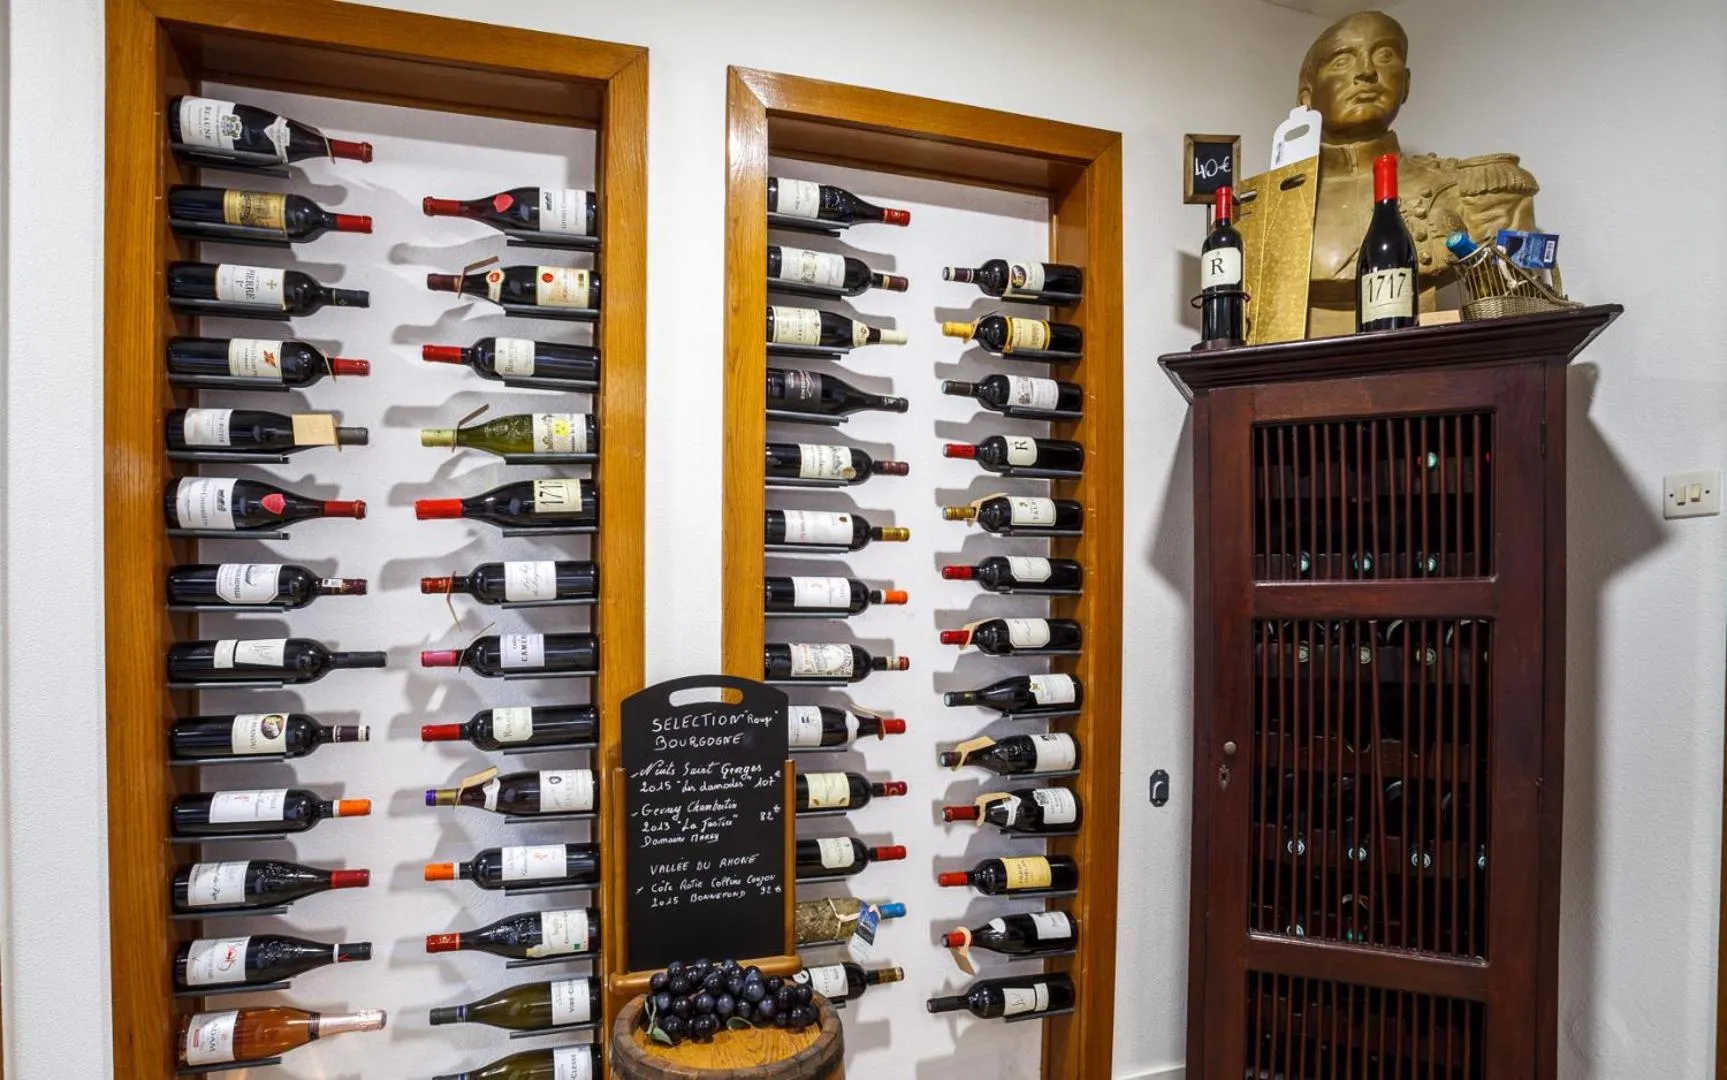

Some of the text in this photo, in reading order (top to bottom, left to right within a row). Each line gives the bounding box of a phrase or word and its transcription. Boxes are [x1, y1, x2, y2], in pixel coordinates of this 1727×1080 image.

[203, 106, 213, 140] BEAUNE
[1195, 156, 1232, 180] 40€
[1210, 257, 1224, 275] R
[1368, 272, 1407, 303] 1717
[1013, 441, 1028, 452] R
[651, 711, 744, 733] SELECTION
[654, 732, 745, 751] BOURGOGNE
[682, 762, 720, 776] Saint
[640, 780, 672, 793] 2015
[641, 821, 671, 833] 2013
[640, 835, 685, 848] Domaine
[693, 861, 712, 871] DU
[651, 896, 680, 908] 2015
